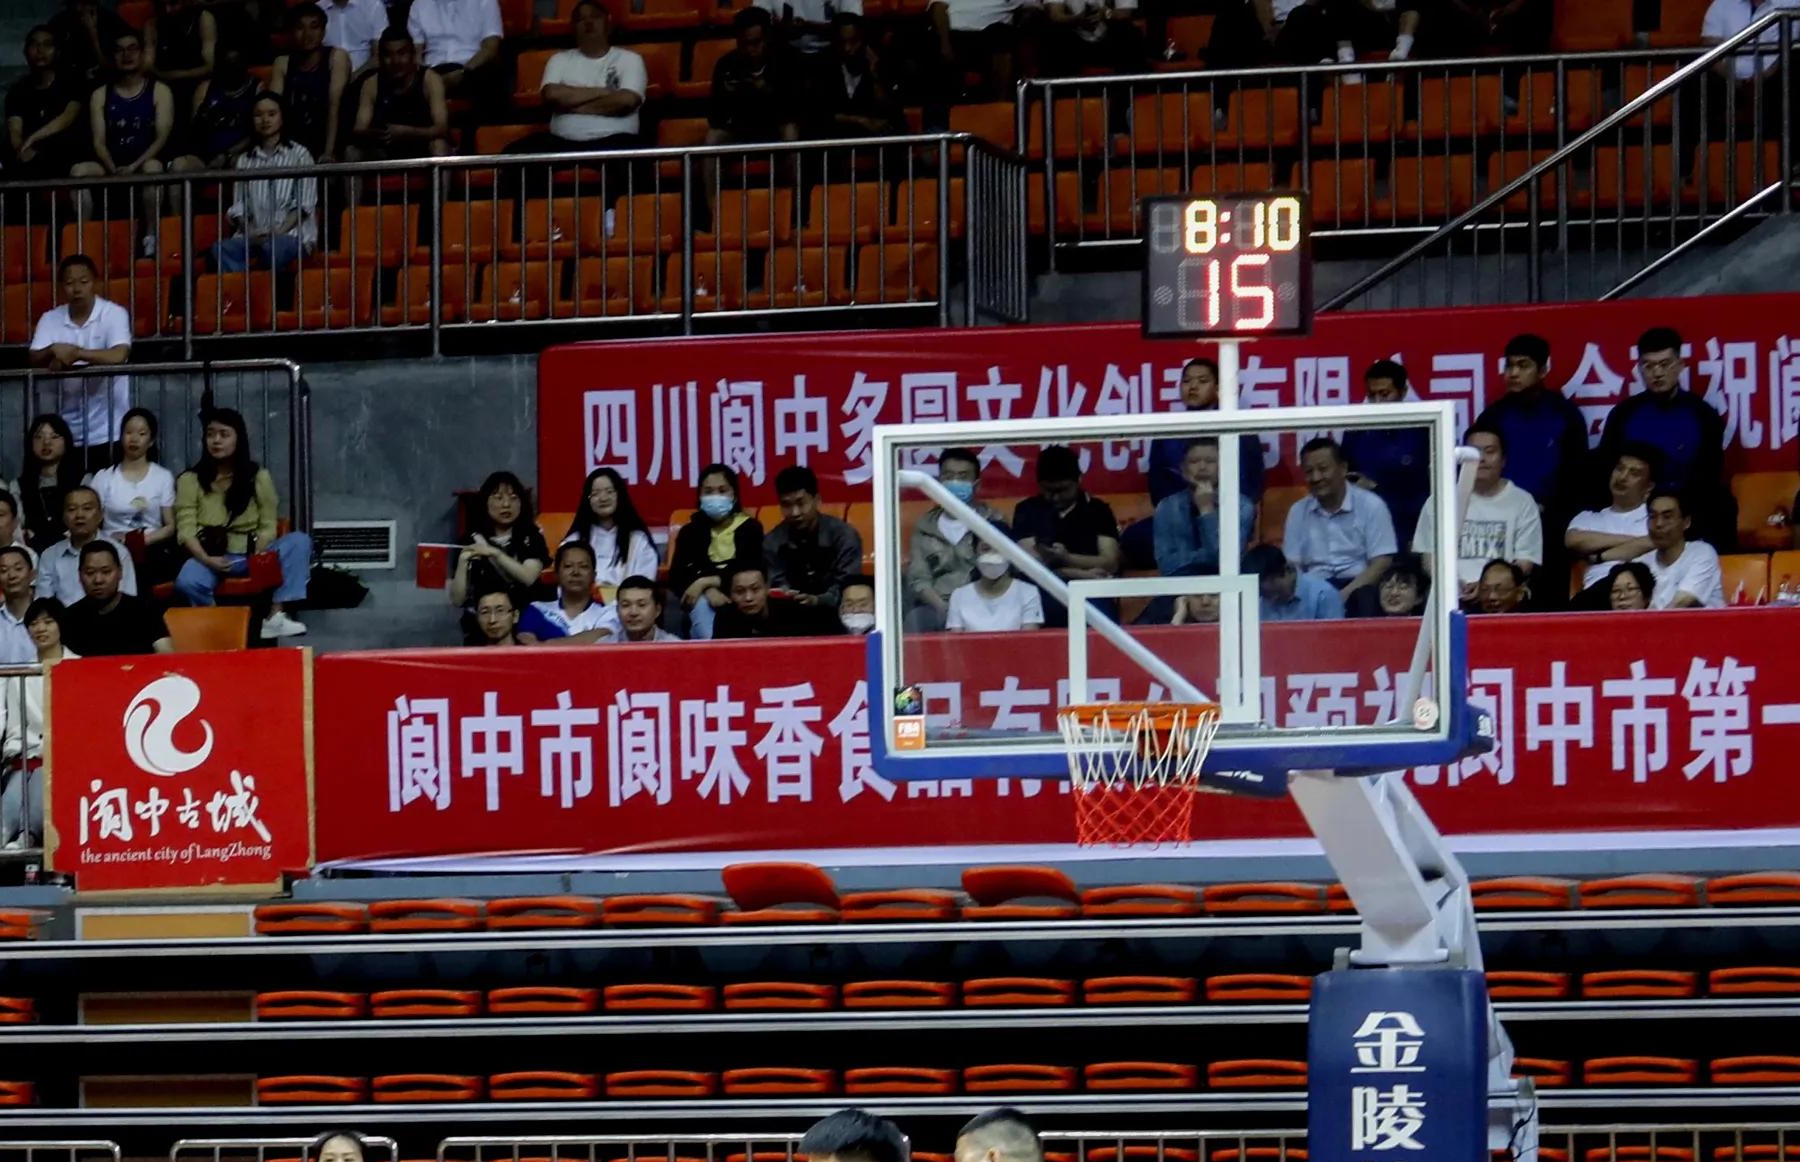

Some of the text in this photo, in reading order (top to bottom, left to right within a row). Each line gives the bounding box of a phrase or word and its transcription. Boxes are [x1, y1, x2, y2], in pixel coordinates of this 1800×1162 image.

[1183, 196, 1301, 255] 8:10
[1205, 252, 1276, 331] 15
[79, 769, 272, 846] 阆中古城
[80, 840, 272, 865] the ancient city of LangZhong
